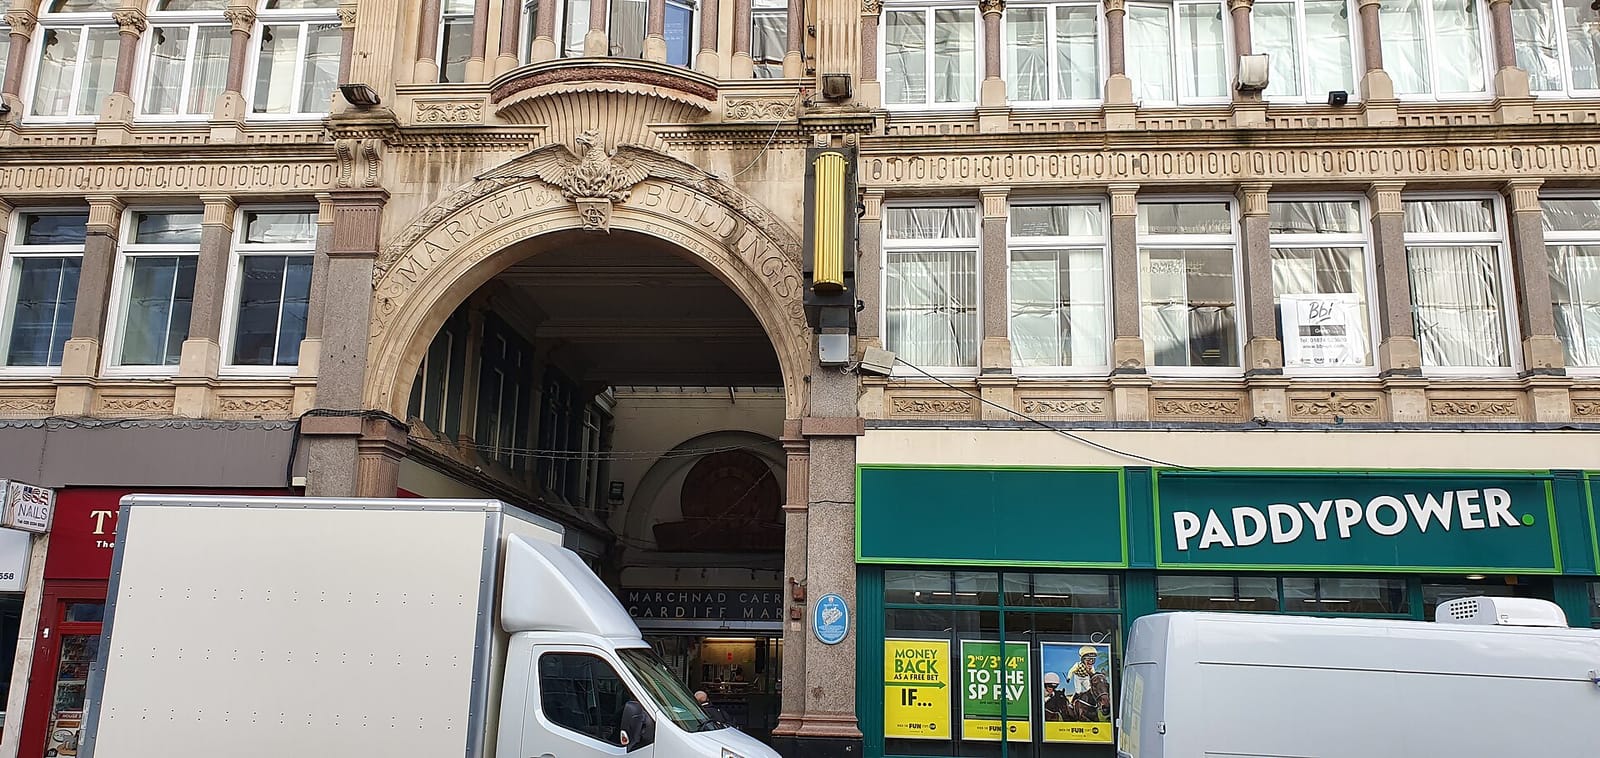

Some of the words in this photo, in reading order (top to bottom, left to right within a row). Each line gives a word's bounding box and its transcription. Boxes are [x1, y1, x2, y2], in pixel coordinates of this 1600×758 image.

[396, 186, 533, 283] MARKET
[640, 182, 803, 299] BUILDINGS
[468, 237, 510, 262] ERECTED
[655, 228, 699, 250] ANDREWS
[706, 251, 725, 266] SON
[1309, 301, 1334, 320] Bbi
[17, 503, 48, 521] NAILS
[90, 510, 120, 535] T
[96, 540, 115, 549] The
[629, 591, 726, 604] MARCHNAD
[739, 593, 783, 604] CAER
[628, 606, 727, 618] CARDIFF
[743, 607, 783, 619] MAR
[895, 649, 938, 659] MONEY
[895, 659, 939, 674] BACK
[967, 669, 990, 683] TO
[993, 670, 1024, 684] THE
[901, 688, 932, 707] IF...
[968, 683, 988, 700] SP
[993, 684, 1025, 701] FAV
